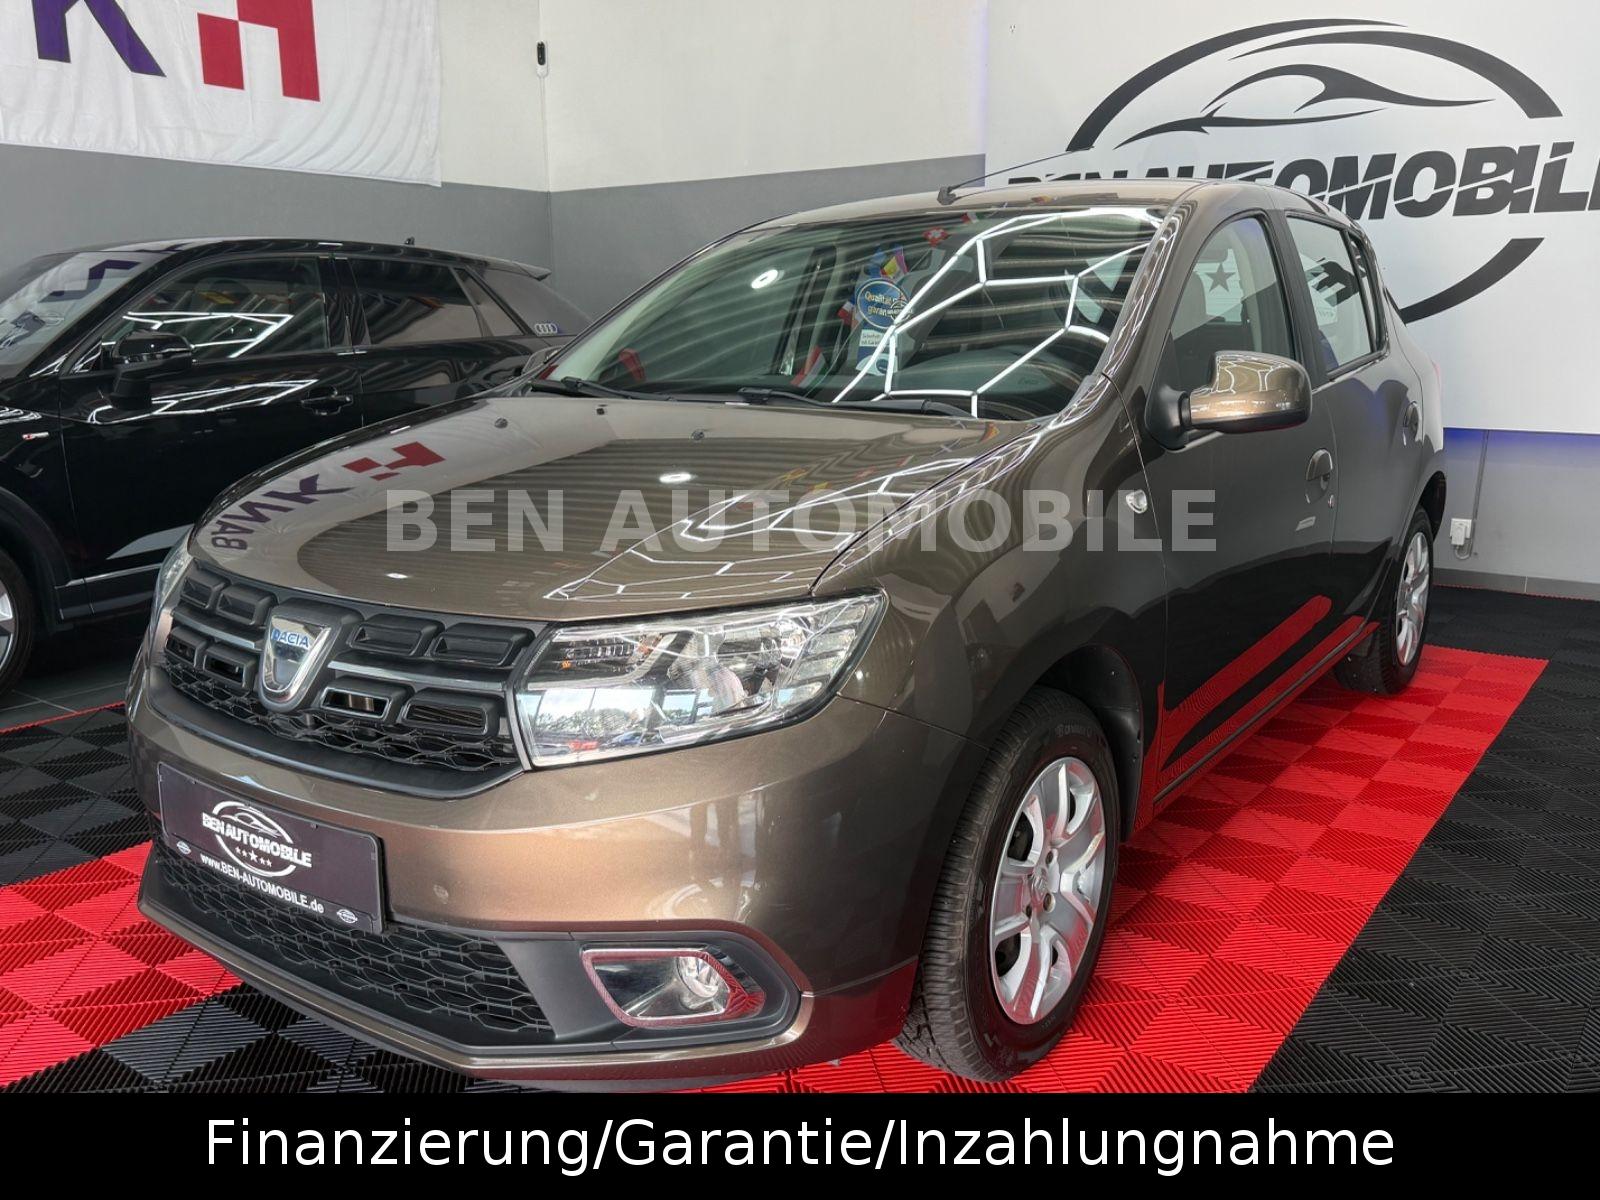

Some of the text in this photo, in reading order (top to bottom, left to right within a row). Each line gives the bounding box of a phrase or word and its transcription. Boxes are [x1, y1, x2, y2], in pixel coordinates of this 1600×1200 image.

[1146, 141, 1600, 220] OMOBIL
[271, 628, 310, 648] DACIA
[202, 812, 225, 835] BEN
[225, 823, 313, 868] AUTOMOBILE
[200, 853, 325, 914] www.BEN-AUTOMOBILE.de
